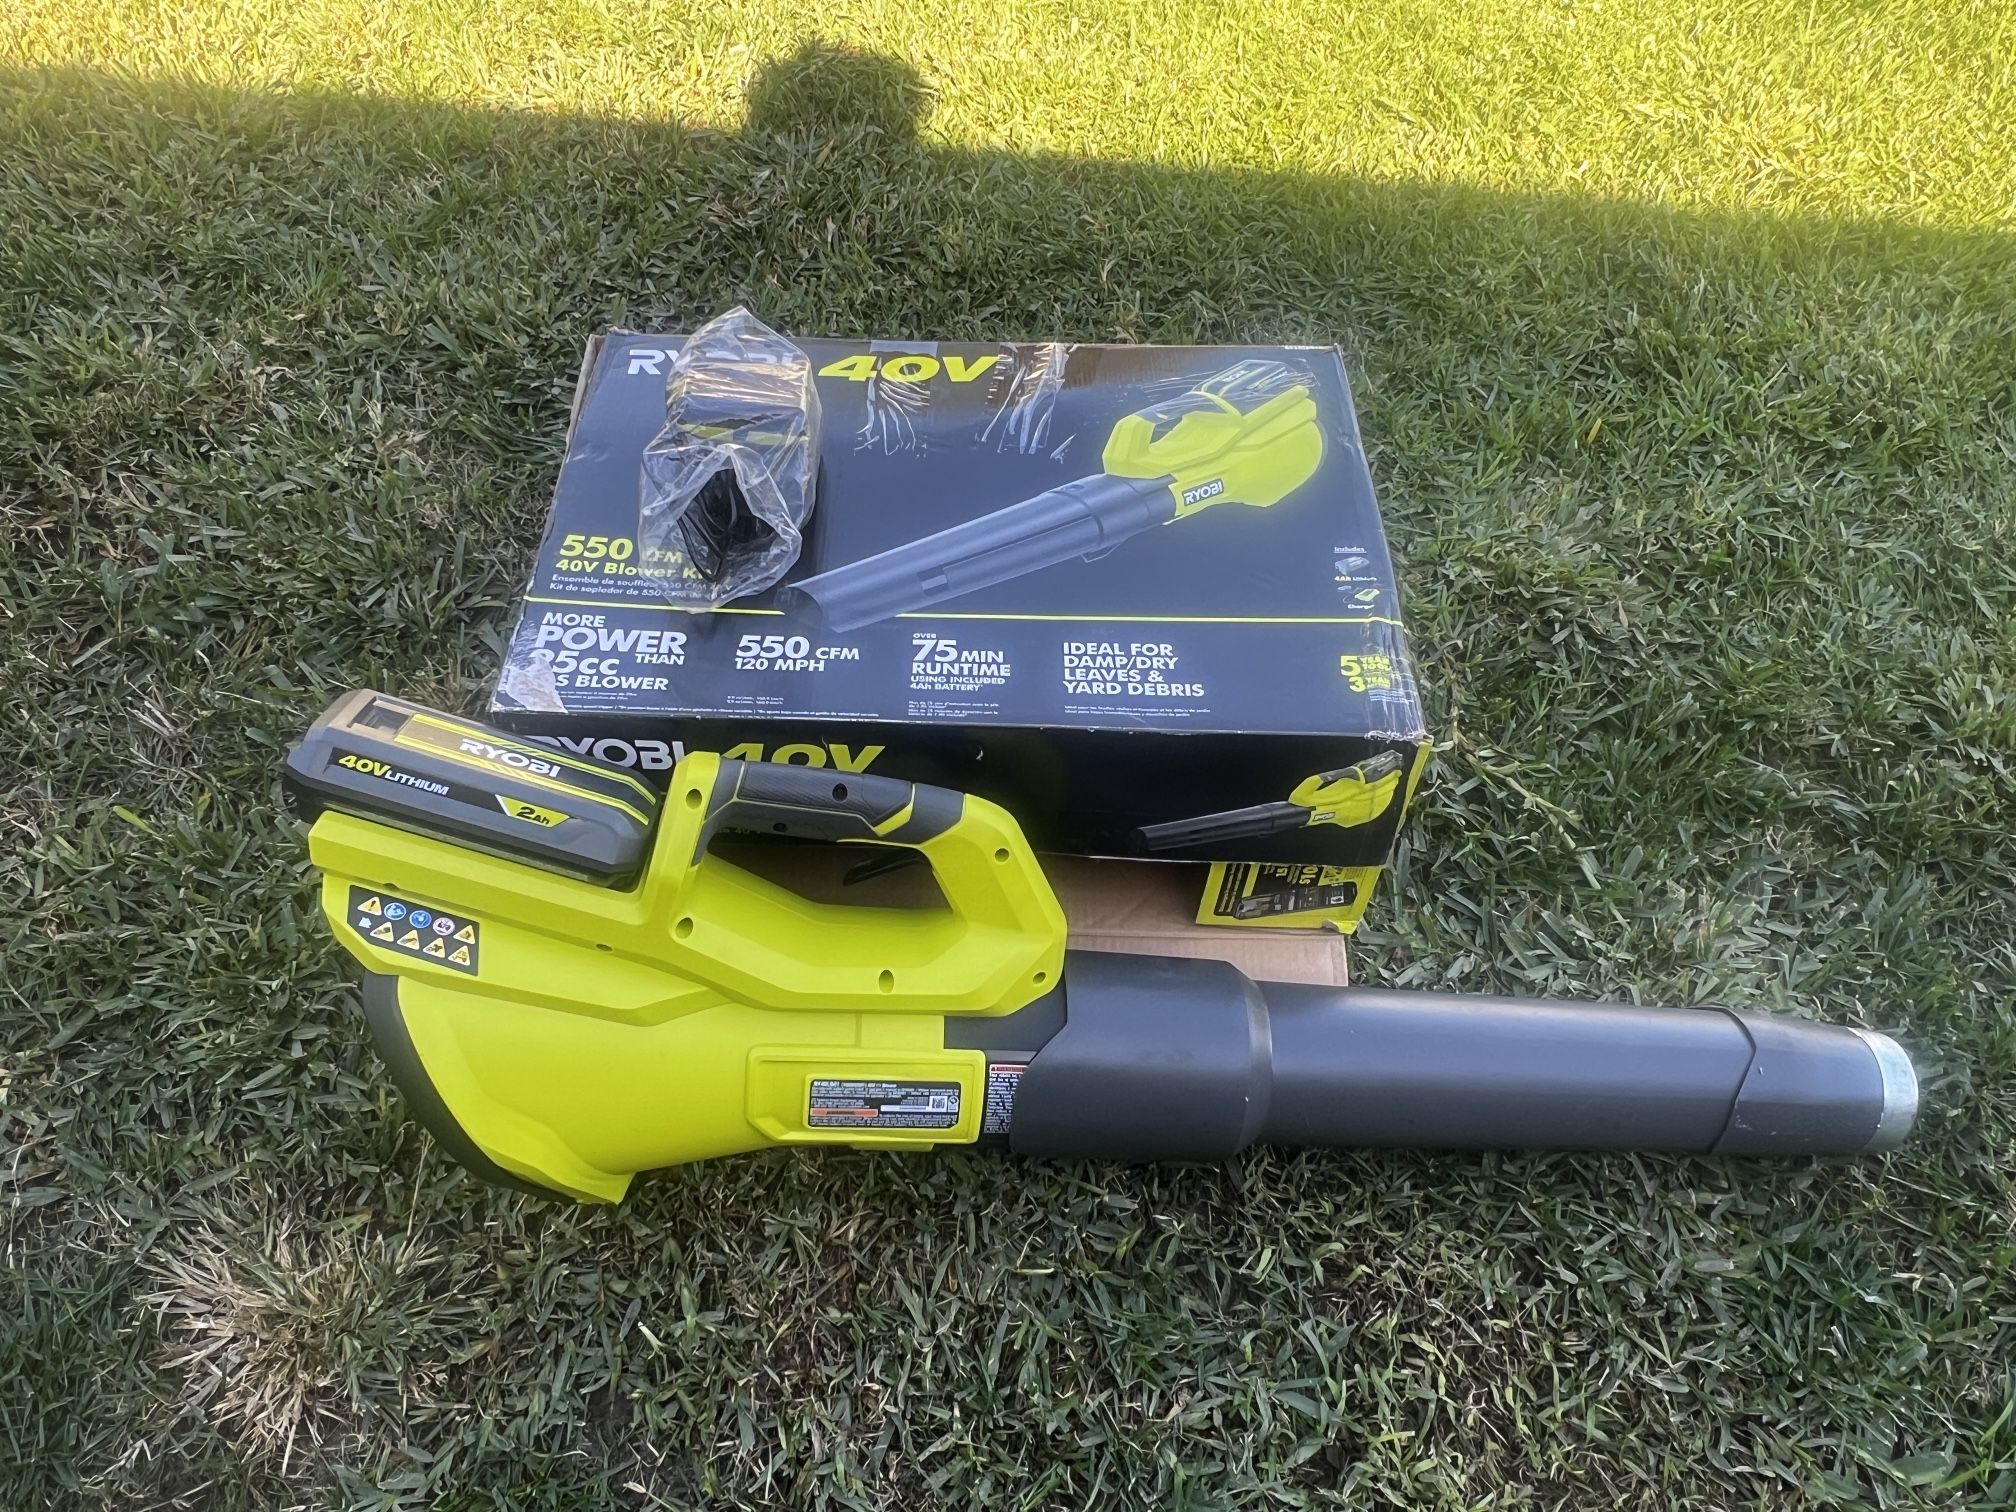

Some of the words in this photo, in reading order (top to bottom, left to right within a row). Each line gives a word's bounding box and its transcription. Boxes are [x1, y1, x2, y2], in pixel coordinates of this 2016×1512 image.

[817, 355, 999, 382] 40V
[1184, 481, 1222, 504] RYOBI
[559, 534, 634, 560] 550
[556, 559, 600, 573] 40V
[603, 562, 677, 578] Blower
[552, 574, 599, 585] Ensemble
[602, 577, 614, 586] de
[550, 582, 559, 590] Kit
[581, 585, 623, 596] soplador
[626, 587, 639, 595] de
[542, 612, 606, 628] MORE
[535, 625, 687, 655] POWER
[736, 634, 810, 659] 550
[815, 647, 860, 660] CFM
[912, 639, 958, 662] 75
[961, 650, 1004, 663] MIN
[1063, 642, 1125, 655] IDEAL
[1130, 643, 1173, 656] FOR
[634, 653, 685, 665] THAN
[735, 658, 768, 670] 120
[774, 659, 825, 672] MPH
[1063, 655, 1179, 670] DAMP/DRY
[1341, 656, 1361, 676] 5
[912, 662, 1011, 677] RUNTIME
[1064, 668, 1141, 682] LEAVES
[1147, 670, 1164, 683] &
[575, 674, 669, 691] BLOWER
[950, 676, 1005, 685] INCLUDED
[1349, 677, 1366, 692] 3
[1063, 681, 1122, 695] YARD
[1127, 683, 1205, 697] DEBRIS
[460, 739, 560, 778] RYOBI
[722, 742, 885, 774] 40V
[516, 806, 551, 825] 2Ah
